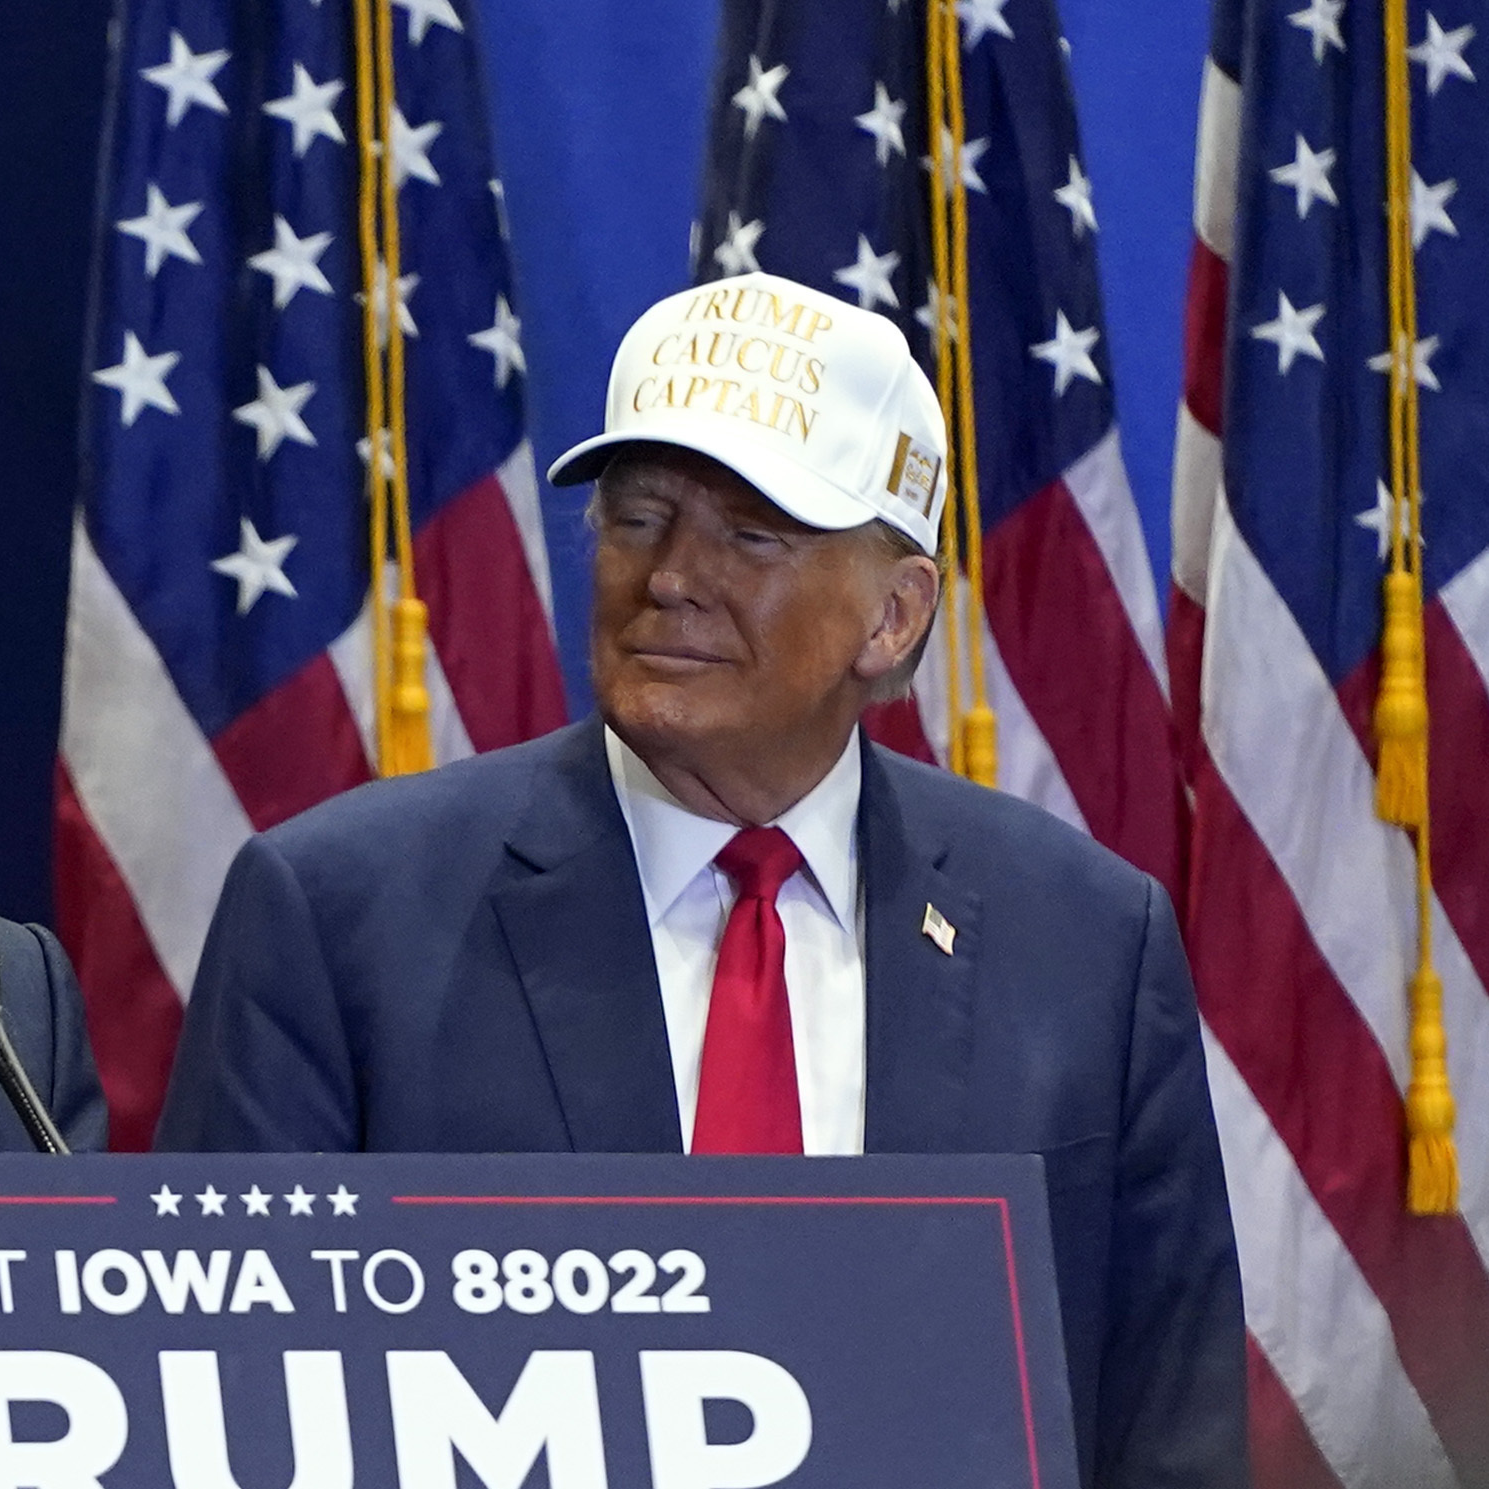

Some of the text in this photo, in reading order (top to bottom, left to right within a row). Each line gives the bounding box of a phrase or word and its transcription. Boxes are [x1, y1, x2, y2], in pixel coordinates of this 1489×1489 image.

[683, 287, 834, 344] TRUMP
[651, 331, 827, 396] CAUCUS
[632, 374, 821, 445] CAPTAIN
[54, 1248, 297, 1316] IOWA
[310, 1248, 425, 1315] TO
[450, 1247, 712, 1315] 88022
